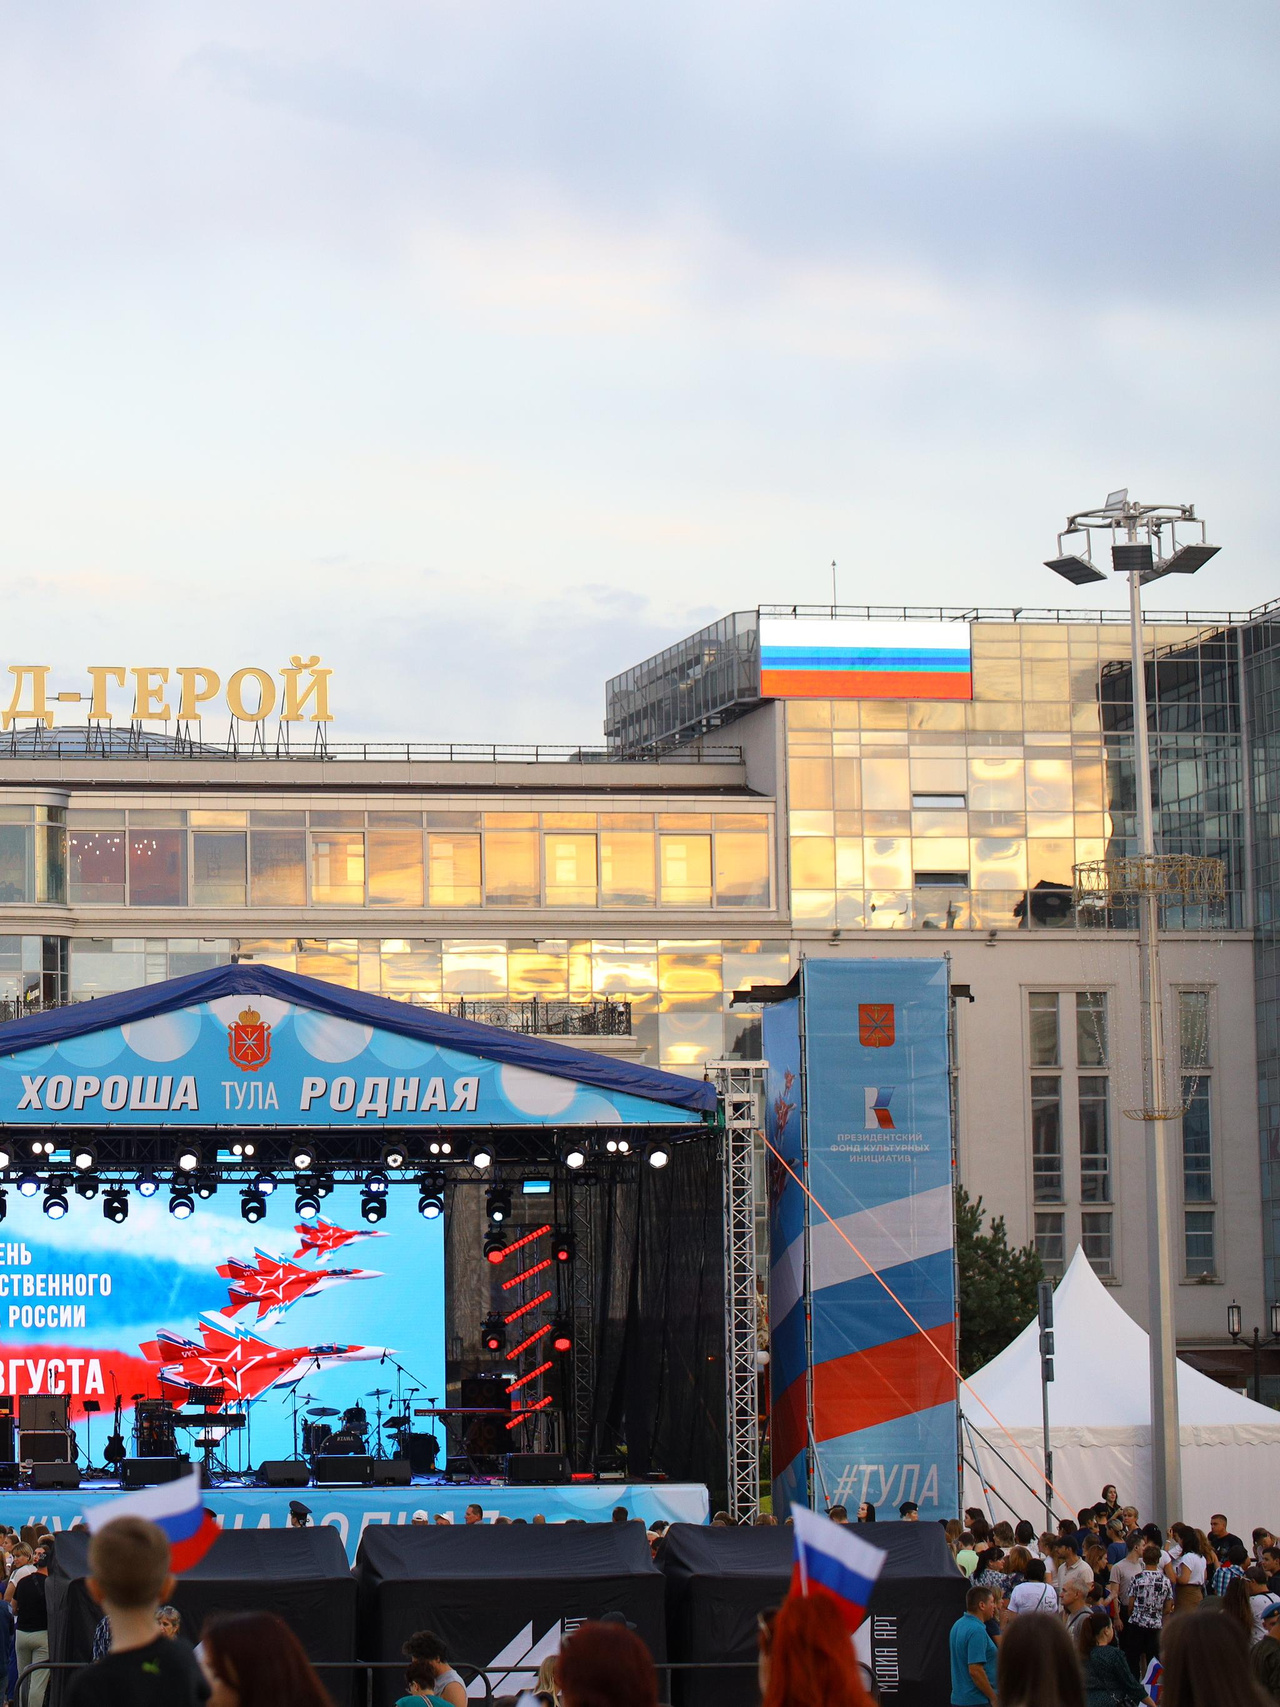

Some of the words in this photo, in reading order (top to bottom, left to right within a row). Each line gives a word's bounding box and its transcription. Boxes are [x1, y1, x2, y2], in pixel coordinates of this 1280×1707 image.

[16, 1075, 199, 1112] ХОРОША
[221, 1080, 279, 1110] ТУЛА
[299, 1076, 481, 1118] РОДНАЯ
[830, 1144, 860, 1153] ФОНД
[863, 1144, 930, 1152] КУЛЬТУРНЫХ
[837, 1132, 923, 1142] ПРЕЗИДЕНТСКИЙ
[849, 1155, 911, 1163] ИНИЦИАТИВ
[8, 1305, 86, 1328] РОССИИ
[833, 1464, 939, 1508] #ТУЛА
[873, 1614, 897, 1639] АРТ
[874, 1648, 900, 1692] МЕДИА
